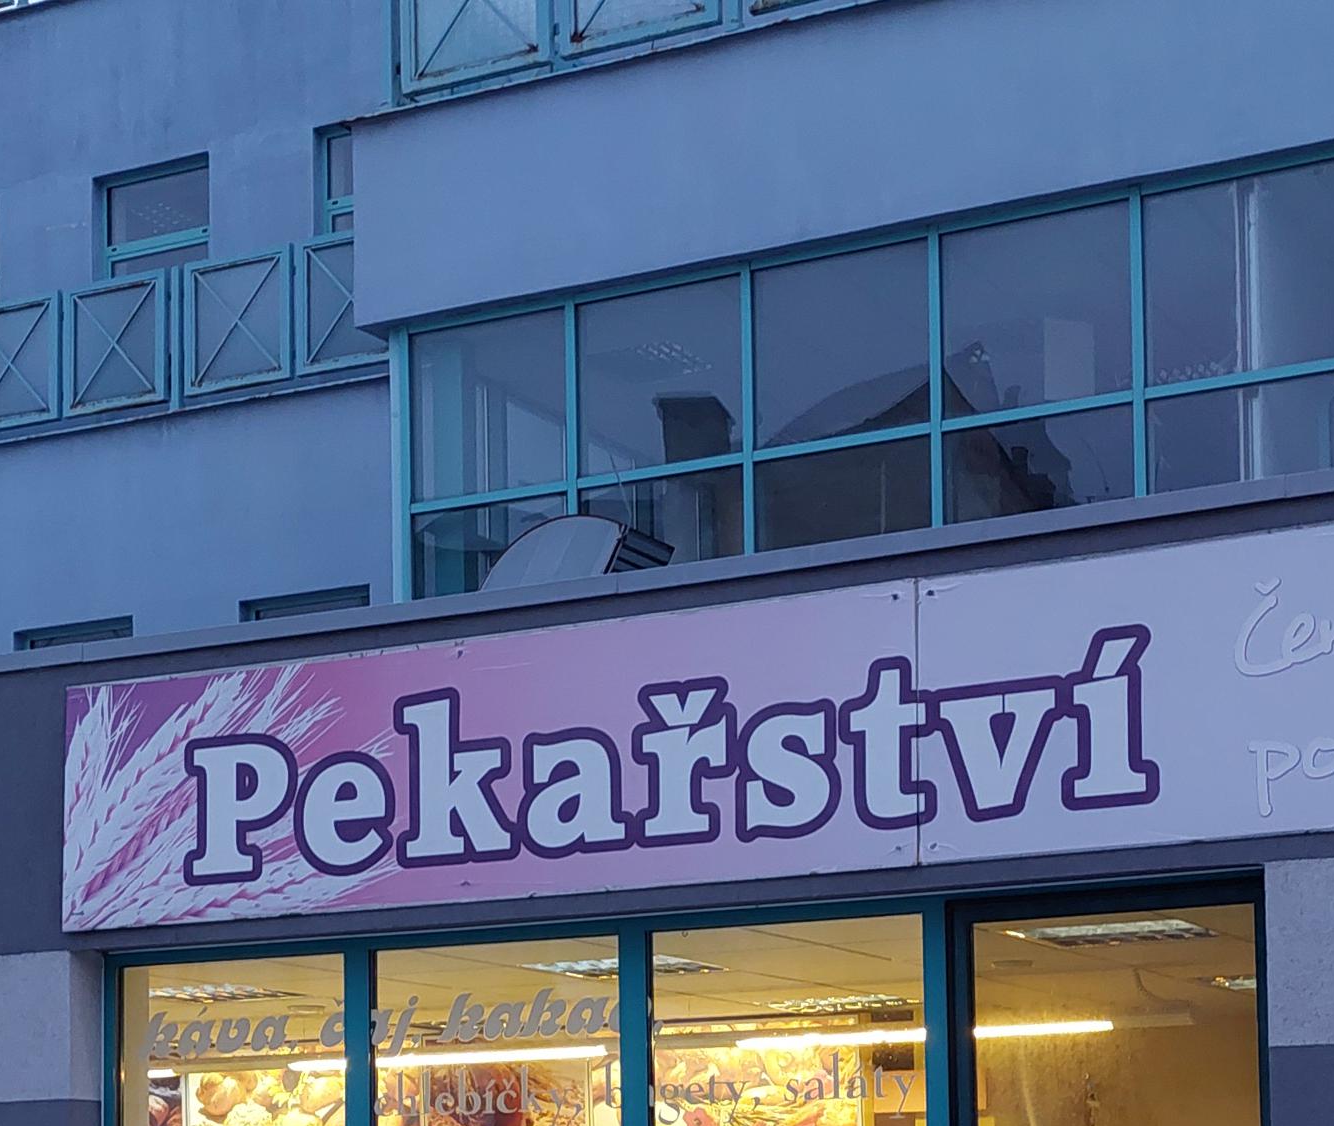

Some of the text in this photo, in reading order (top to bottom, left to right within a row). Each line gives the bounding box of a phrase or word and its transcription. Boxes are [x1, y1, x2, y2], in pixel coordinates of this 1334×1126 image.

[184, 623, 1161, 887] Pekařství
[139, 1005, 299, 1058] káva,
[783, 1053, 915, 1120] saláty
